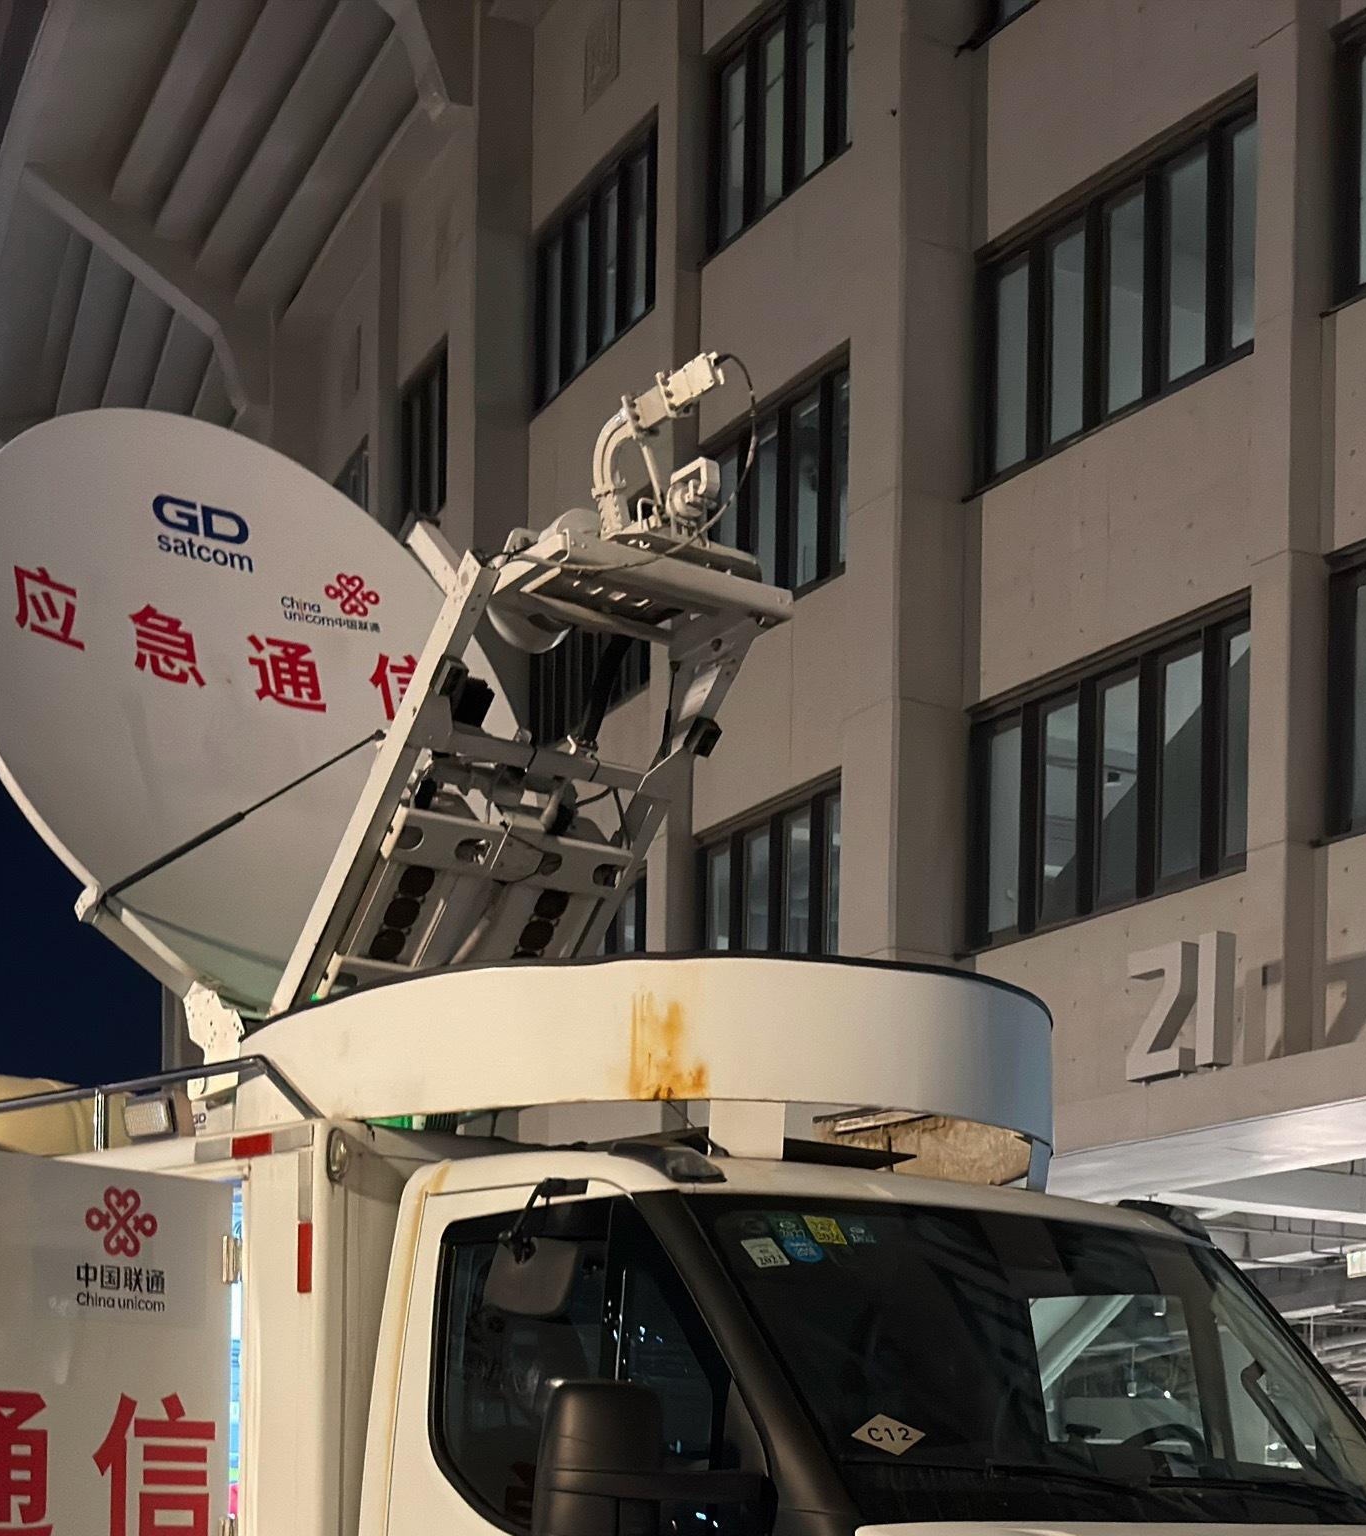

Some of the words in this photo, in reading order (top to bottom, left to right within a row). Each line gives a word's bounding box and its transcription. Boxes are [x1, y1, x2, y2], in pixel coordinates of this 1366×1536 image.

[152, 494, 249, 545] GD
[157, 534, 254, 573] satcom
[281, 596, 322, 614] China
[76, 1262, 165, 1295] 中国联通
[76, 1291, 115, 1309] China
[117, 1296, 165, 1312] unicom
